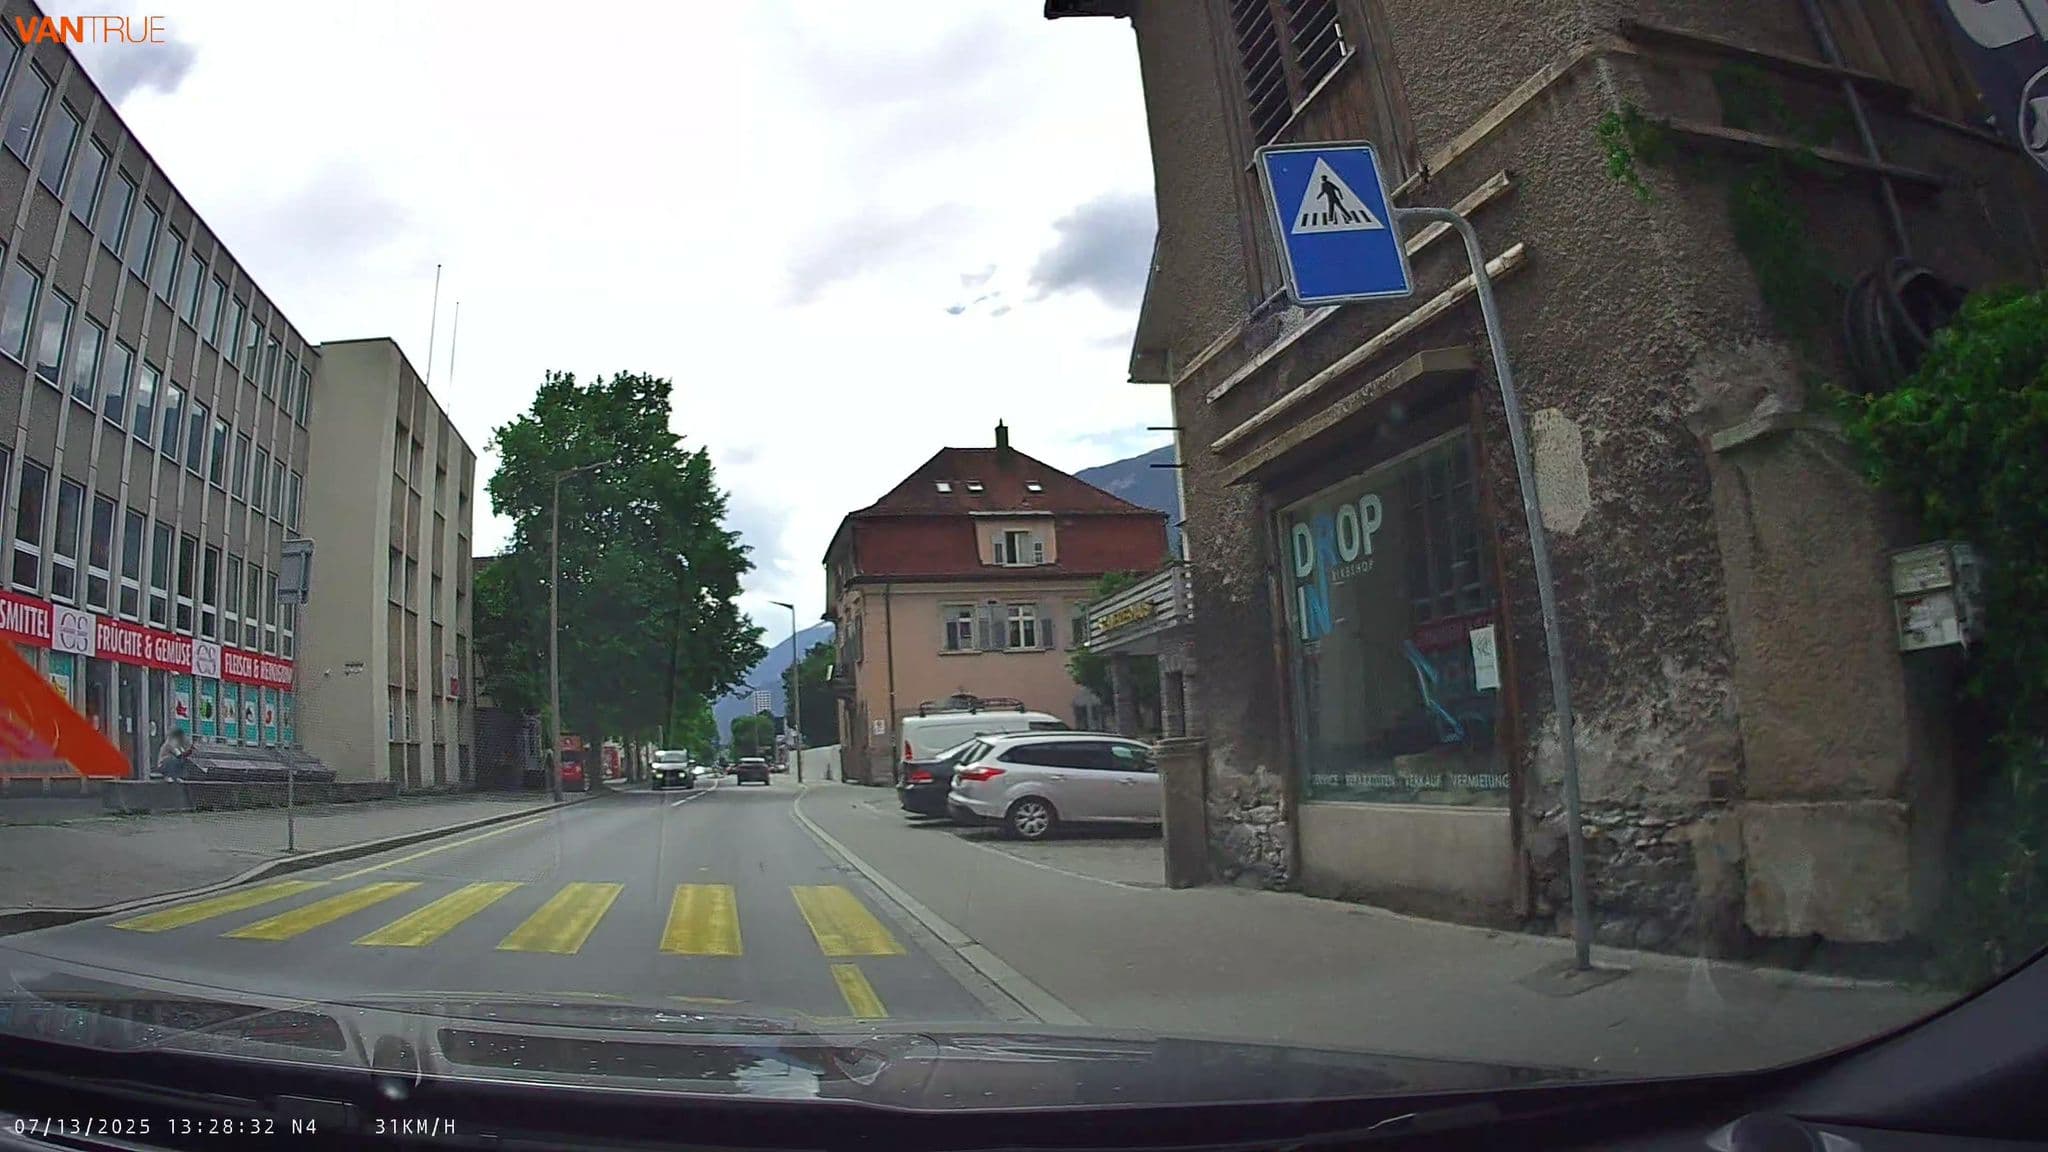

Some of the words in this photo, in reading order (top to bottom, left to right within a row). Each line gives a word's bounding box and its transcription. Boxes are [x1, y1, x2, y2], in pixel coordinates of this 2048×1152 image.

[1293, 494, 1382, 577] DROP
[1298, 584, 1332, 641] IN
[97, 621, 142, 658] FRÜCHTE
[144, 634, 152, 660] &
[155, 637, 191, 666] GEMÜSE
[225, 653, 252, 678] FLEISCH
